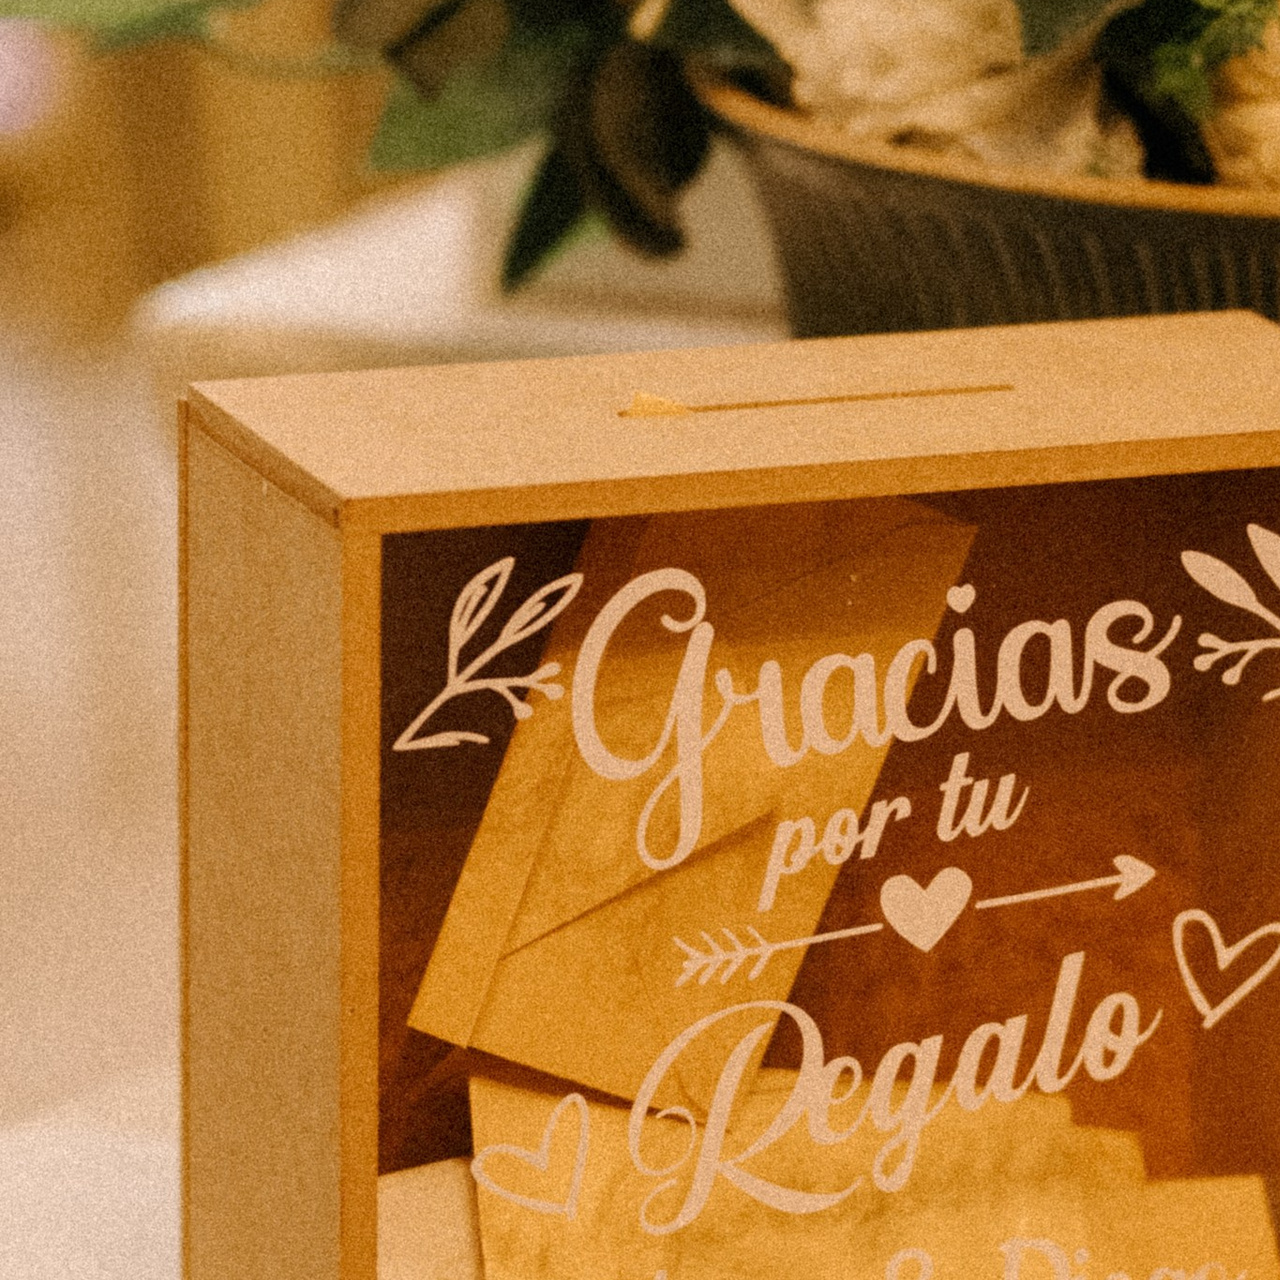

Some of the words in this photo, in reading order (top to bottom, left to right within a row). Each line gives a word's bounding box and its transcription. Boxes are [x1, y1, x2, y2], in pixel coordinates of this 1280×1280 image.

[570, 566, 1182, 871] Gracias
[758, 793, 912, 912] por
[936, 752, 1030, 843] tu
[628, 951, 1163, 1236] Regalo
